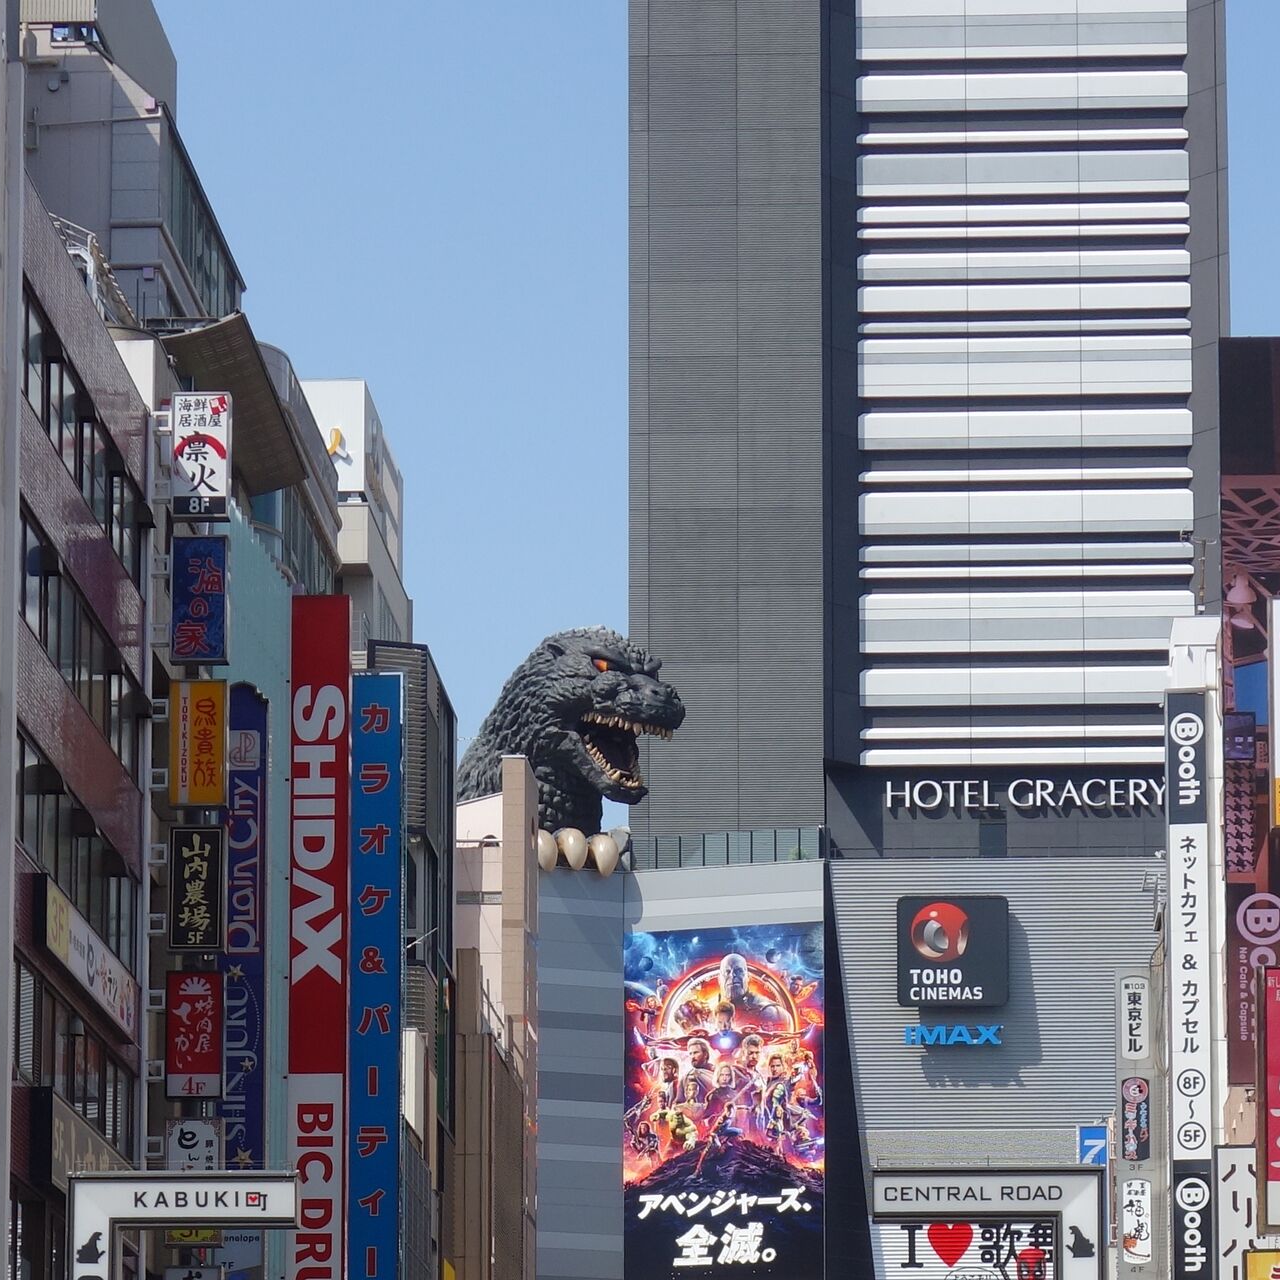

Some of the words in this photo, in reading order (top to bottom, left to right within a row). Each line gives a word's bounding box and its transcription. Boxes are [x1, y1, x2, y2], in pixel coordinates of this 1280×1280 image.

[178, 398, 208, 412] 海鮮
[178, 414, 223, 428] 居酒屋
[188, 499, 210, 514] 8F
[193, 698, 218, 789] 鳥貴族
[1170, 712, 1204, 805] Booth
[886, 779, 1000, 809] HOTEL
[1008, 777, 1167, 807] GRACERY
[291, 684, 345, 985] SHIDAX
[179, 833, 211, 932] 山内農場
[1180, 835, 1199, 943] ネットカフェ
[188, 932, 204, 945] 5F
[910, 970, 963, 985] TOHO
[1182, 954, 1197, 970] &
[910, 986, 984, 1002] CINEMAS
[1127, 992, 1143, 1053] 東京ビル
[1181, 978, 1199, 1055] カプセル
[904, 1024, 1005, 1046] IMAX
[181, 1077, 206, 1096] 4F
[295, 1103, 333, 1185] BIC
[884, 1186, 993, 1202] CENTRAL
[1001, 1184, 1063, 1202] ROAD
[1175, 1177, 1210, 1273] Booth
[672, 1222, 777, 1266] 全滅。
